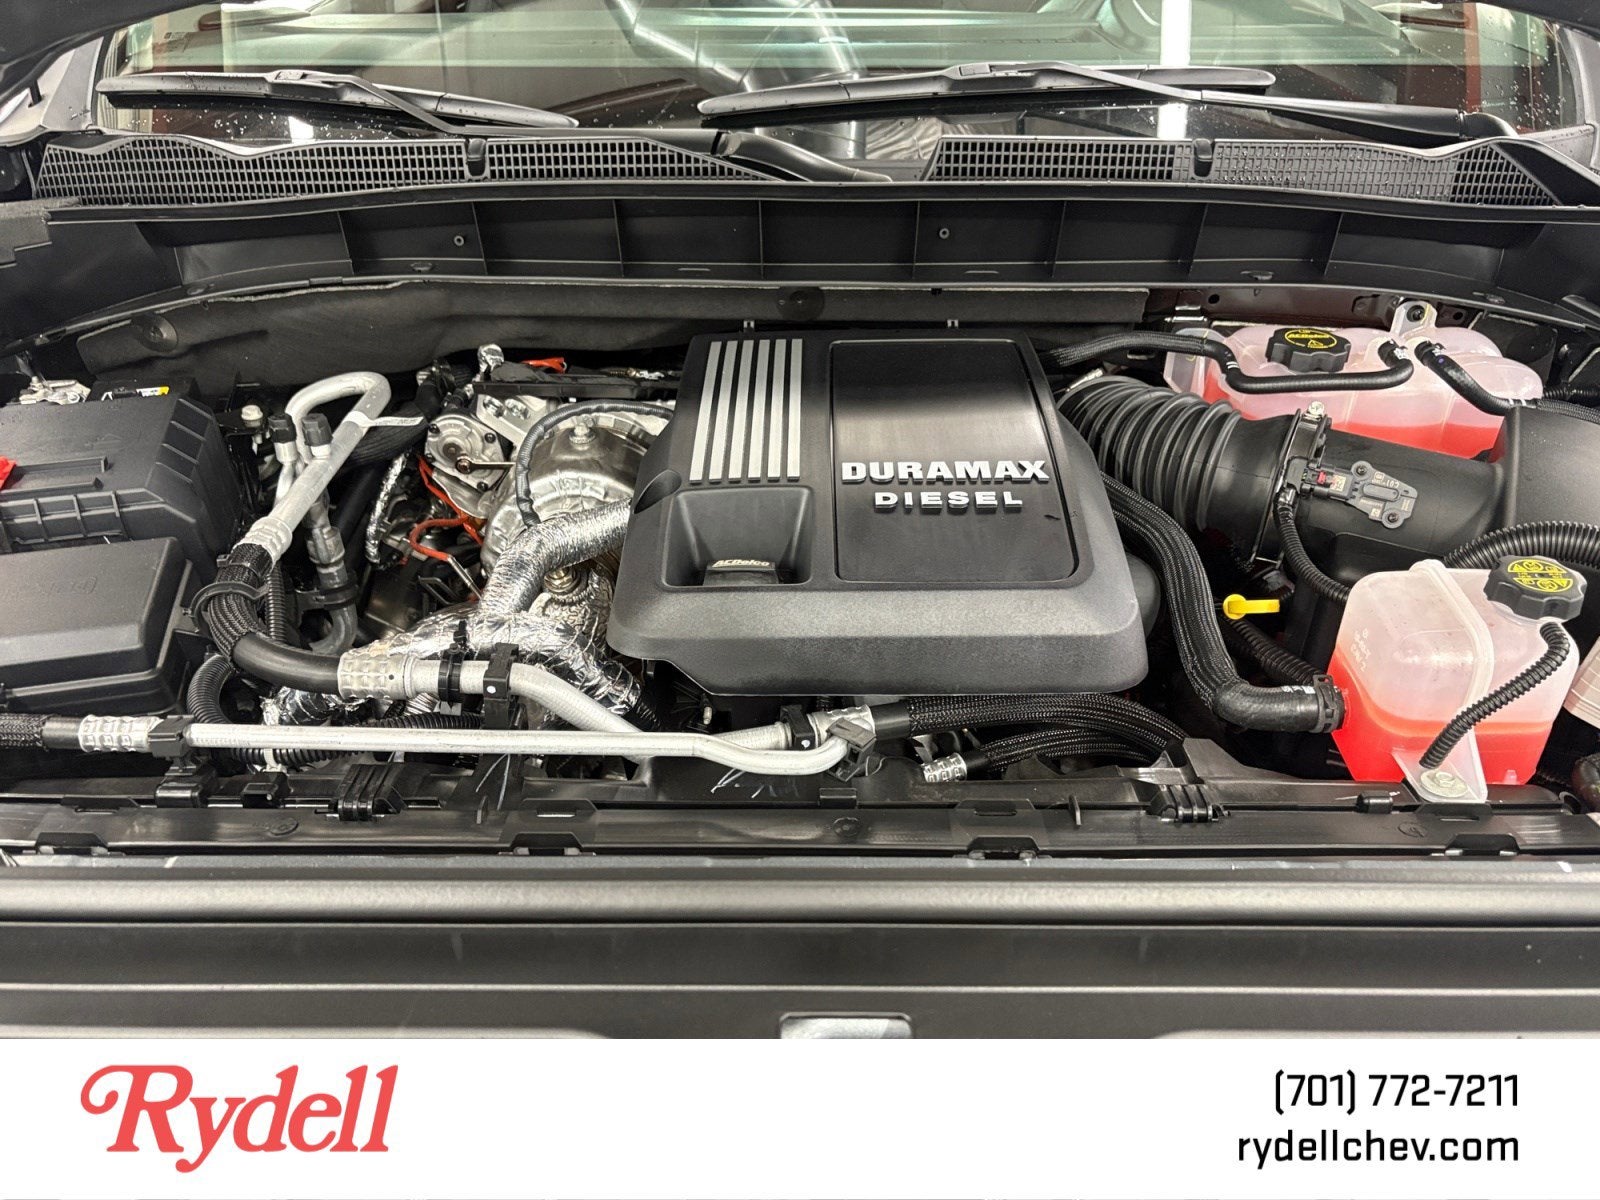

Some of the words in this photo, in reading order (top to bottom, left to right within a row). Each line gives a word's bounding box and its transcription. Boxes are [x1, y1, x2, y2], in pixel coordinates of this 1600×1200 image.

[841, 460, 1050, 483] DURAMAX
[874, 491, 1024, 509] DIESEL
[711, 558, 770, 568] ACDelco
